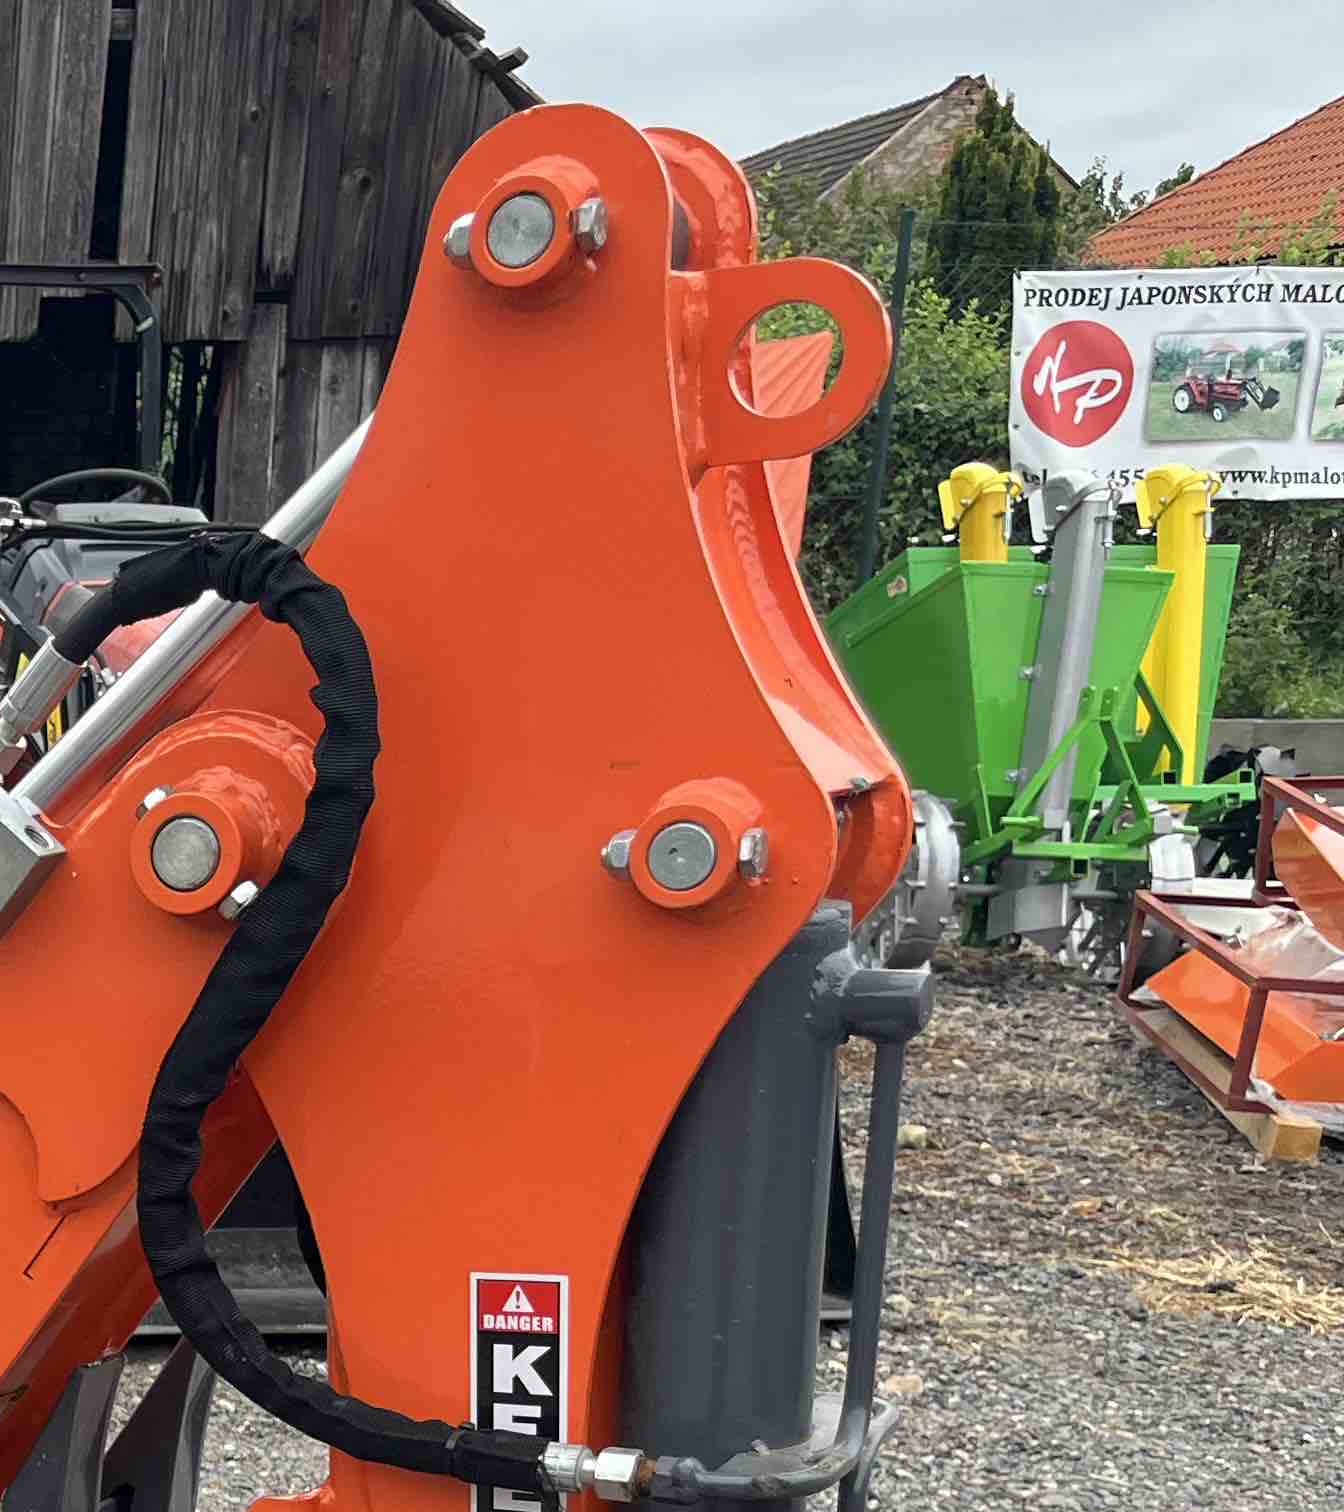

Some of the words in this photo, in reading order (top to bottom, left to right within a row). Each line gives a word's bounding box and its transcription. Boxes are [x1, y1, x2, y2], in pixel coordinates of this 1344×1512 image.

[1023, 287, 1114, 311] PRODEJ
[1115, 278, 1274, 311] JAPONSKÝCH
[483, 1313, 553, 1332] DANGER
